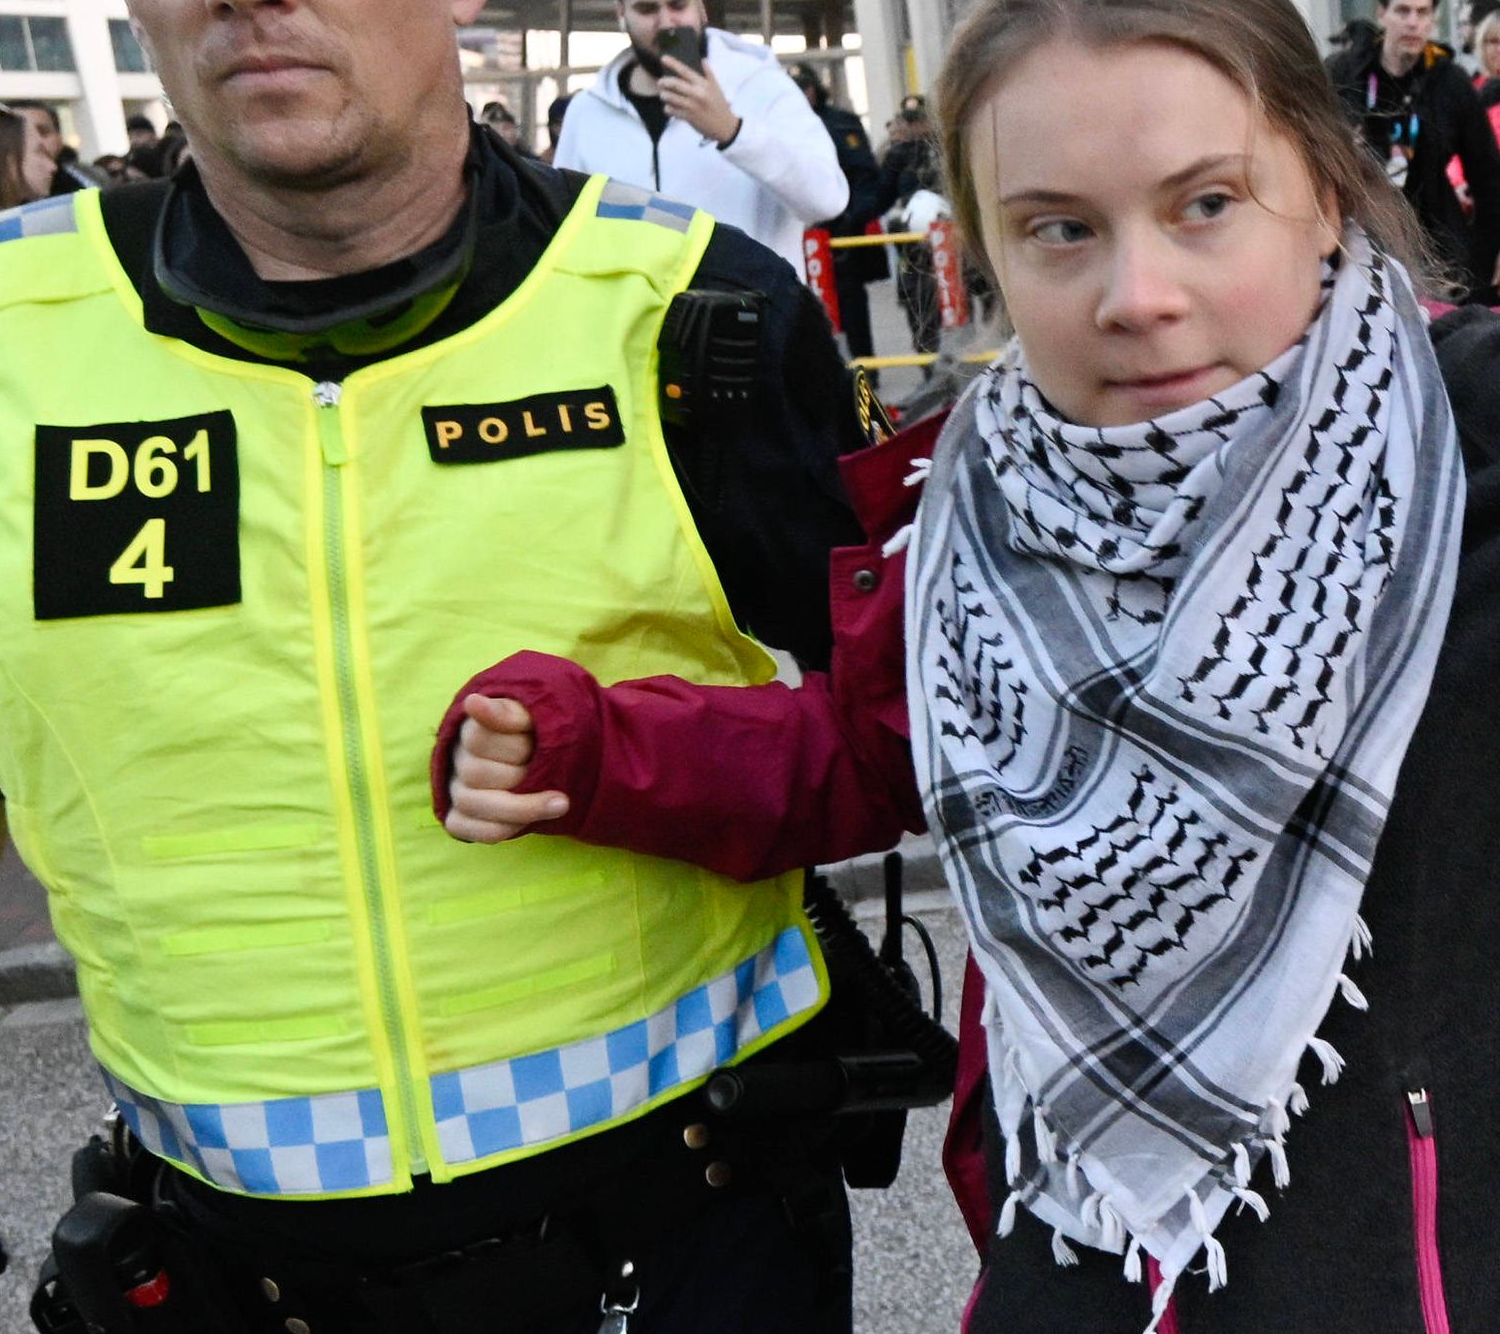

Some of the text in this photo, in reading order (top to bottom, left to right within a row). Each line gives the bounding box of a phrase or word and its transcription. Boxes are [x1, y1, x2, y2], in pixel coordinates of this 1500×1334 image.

[435, 402, 611, 449] POLIS
[70, 429, 211, 501] D61
[109, 518, 174, 598] 4
